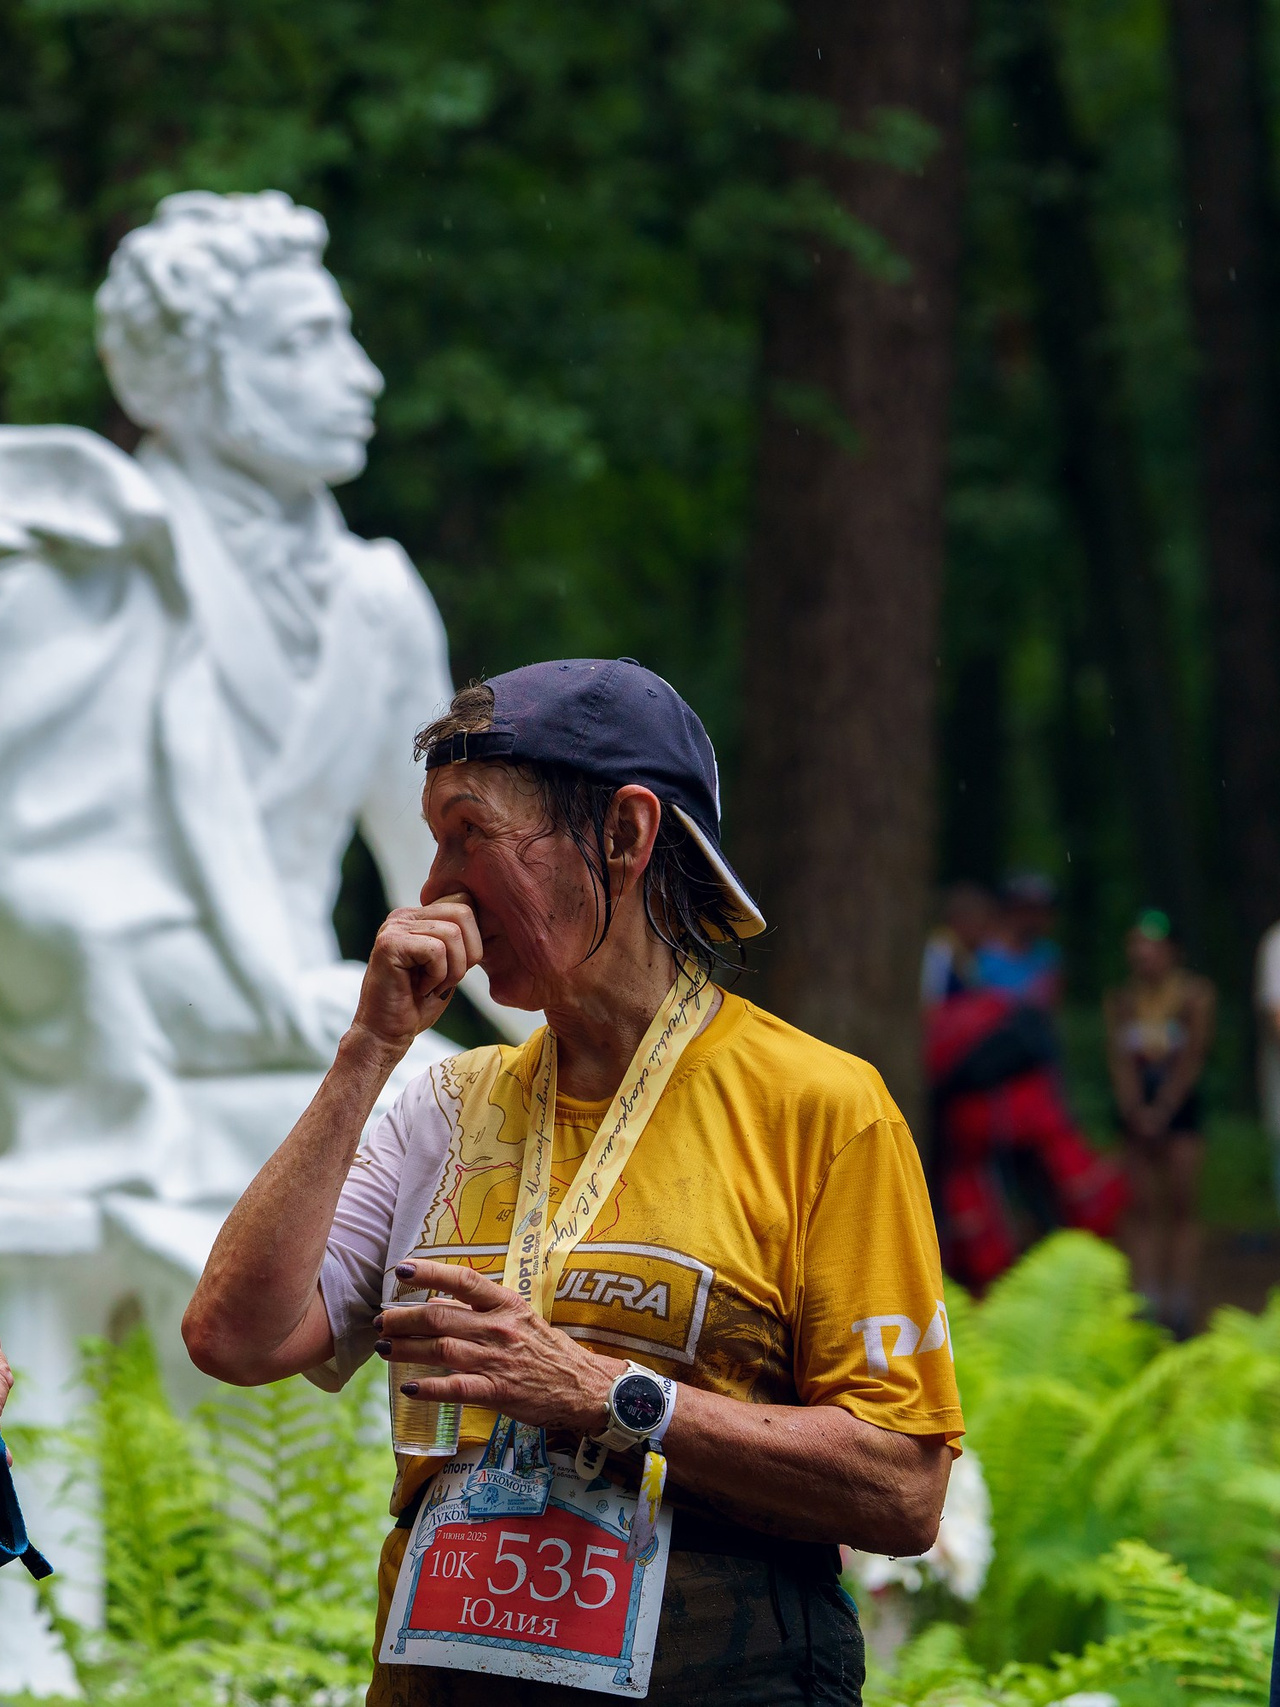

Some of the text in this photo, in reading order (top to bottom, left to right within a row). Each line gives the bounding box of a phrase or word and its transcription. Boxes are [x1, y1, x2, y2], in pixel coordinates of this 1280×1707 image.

[518, 1233, 535, 1302] ПОРТ 40
[554, 1270, 668, 1317] ULTRA
[443, 1462, 475, 1475] СПОРТ
[436, 1529, 488, 1543] 7 июня 2025
[487, 1531, 619, 1610] 535
